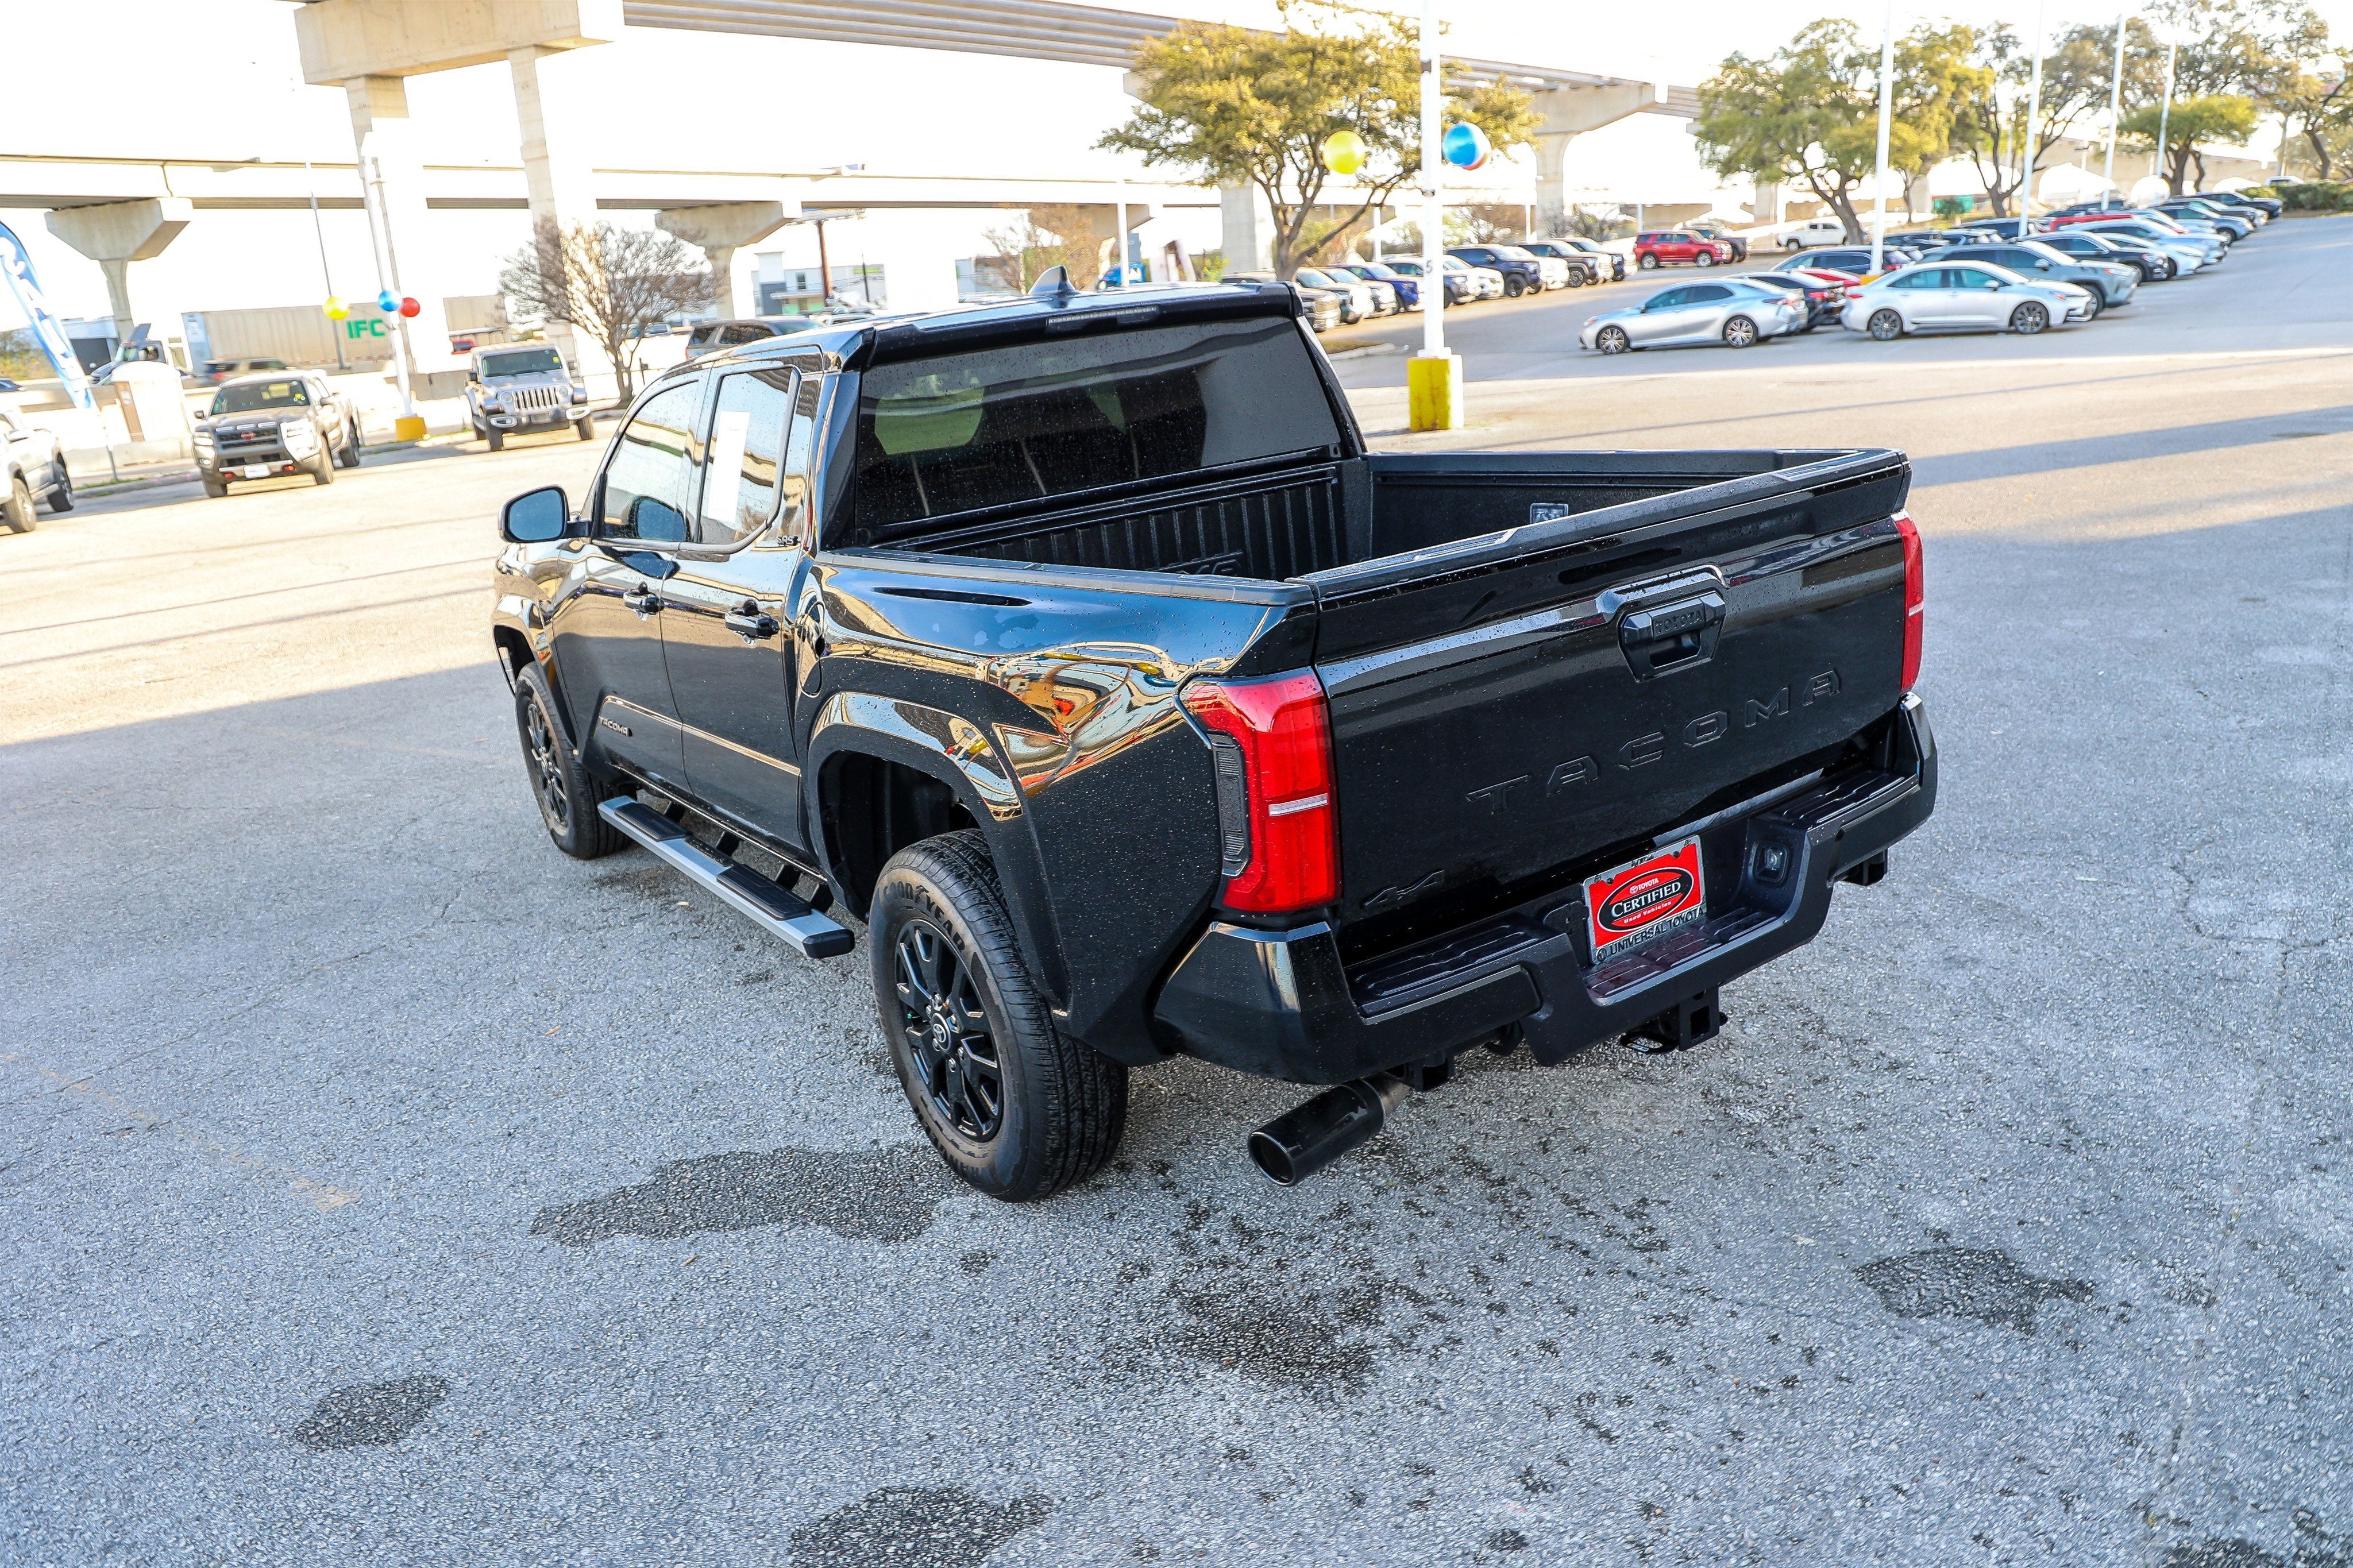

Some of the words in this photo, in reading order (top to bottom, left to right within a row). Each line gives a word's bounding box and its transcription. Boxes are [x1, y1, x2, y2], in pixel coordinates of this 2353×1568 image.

[1426, 260, 1434, 273] 5
[347, 319, 386, 339] IFC
[1654, 611, 1703, 634] TOYOTA
[599, 716, 630, 736] TACOMA
[1465, 668, 1841, 816] TACOMA
[1637, 877, 1660, 891] TOYOTA
[1611, 881, 1681, 918] CERTIFIED
[883, 880, 966, 952] GOODYEAR
[1623, 912, 1642, 924] Used
[1643, 901, 1672, 916] Vehicles
[1608, 921, 1667, 955] UNIVERSAL
[1667, 905, 1704, 929] TOYOTA
